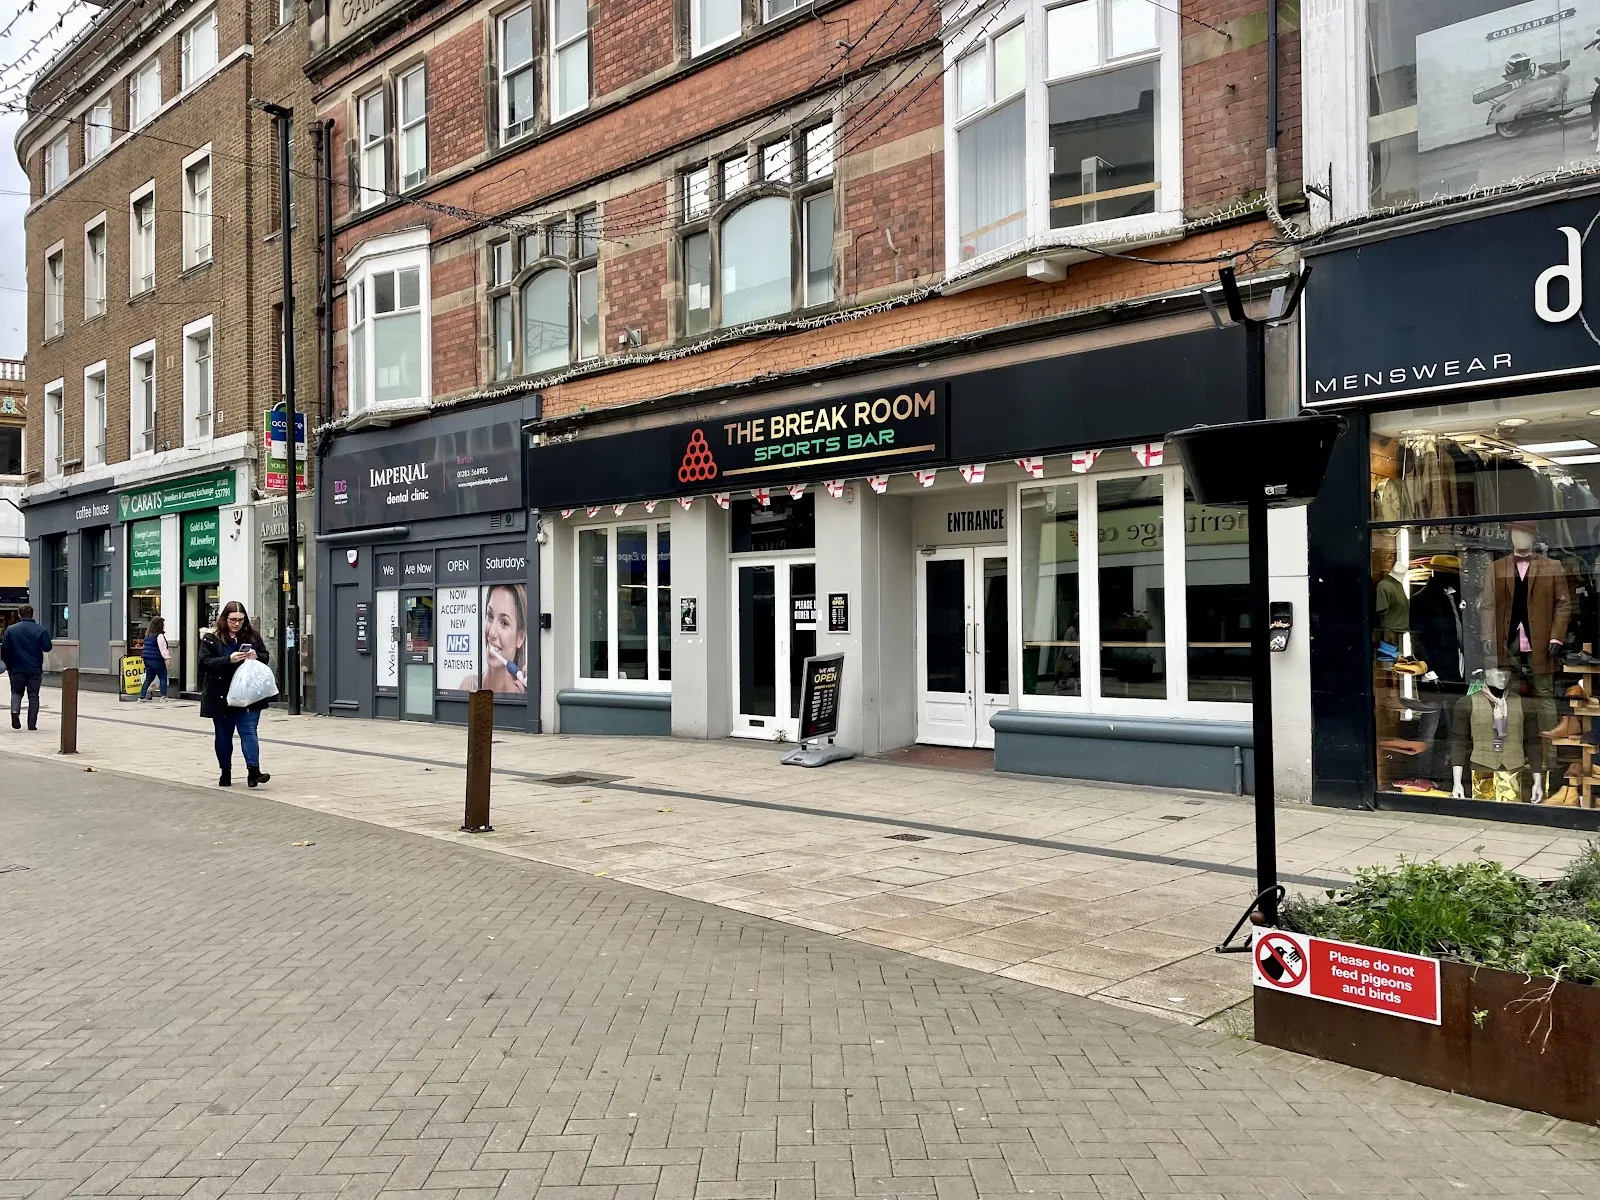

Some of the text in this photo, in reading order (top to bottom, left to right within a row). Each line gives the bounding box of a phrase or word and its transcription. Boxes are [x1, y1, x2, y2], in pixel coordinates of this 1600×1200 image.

[1493, 18, 1547, 38] CARNABY
[1315, 353, 1512, 394] MENSWEAR
[724, 390, 936, 446] THE BREAK ROOM
[754, 429, 895, 462] SPORTS BAR
[457, 456, 473, 465] Burton
[369, 463, 428, 488] IMPERIAL
[197, 487, 214, 496] Exchange
[387, 488, 429, 505] dental clinic
[131, 492, 162, 513] CARATS
[272, 503, 289, 518] BAN
[76, 504, 109, 520] coffee house
[190, 522, 200, 532] Gold
[204, 521, 216, 530] Silver
[947, 508, 1004, 533] ENTRANCE
[261, 521, 305, 537] APARTMTS
[189, 557, 203, 570] Bought
[208, 556, 217, 566] Sold
[383, 557, 525, 576] We Are Now OPEN Saturdays
[450, 590, 467, 600] NOW
[441, 604, 477, 615] ACCEPTING
[795, 600, 812, 609] PLEASE
[451, 619, 466, 629] NEW
[447, 636, 469, 651] NHS
[443, 660, 473, 670] PATIENTS
[814, 673, 837, 683] OPEN
[1329, 951, 1415, 977] Please do not
[1331, 965, 1413, 992] feed pigeons
[1342, 983, 1402, 1004] and birds
